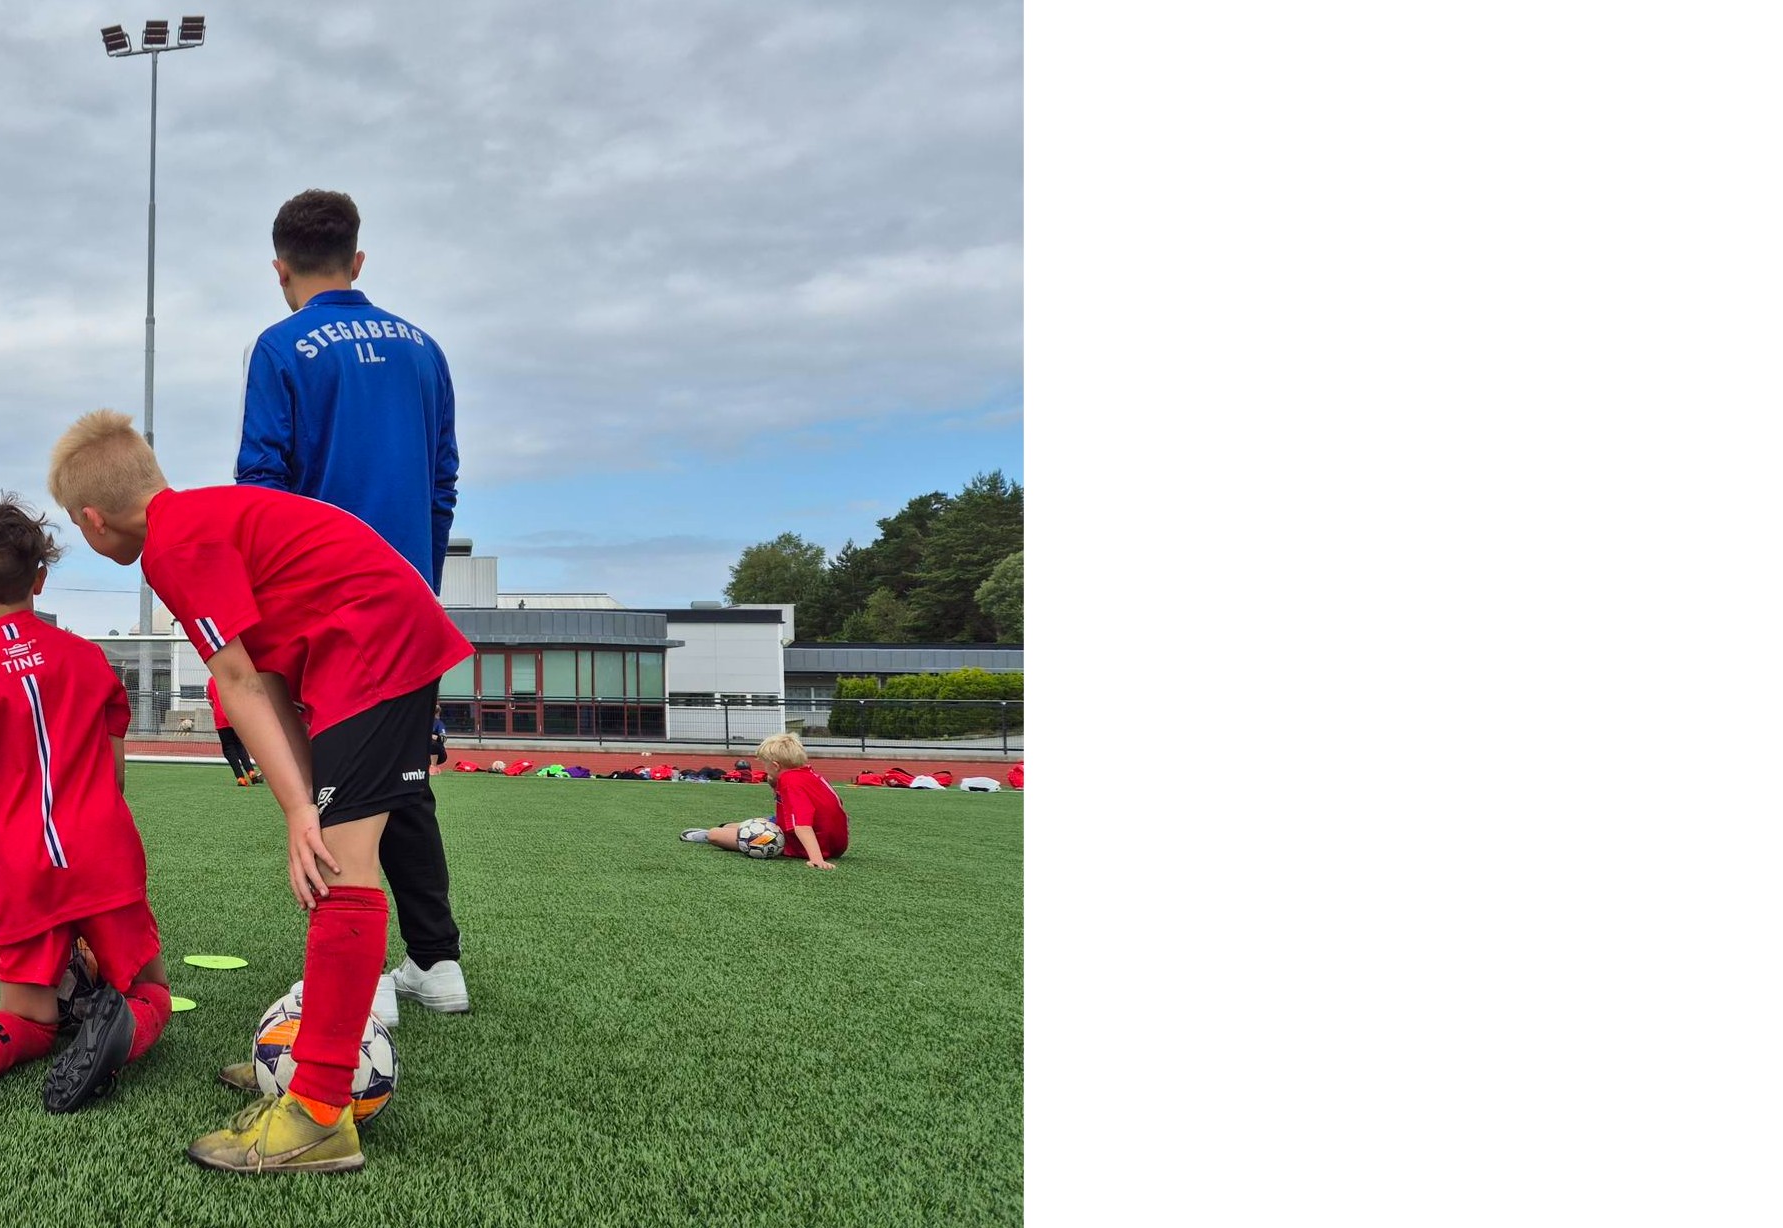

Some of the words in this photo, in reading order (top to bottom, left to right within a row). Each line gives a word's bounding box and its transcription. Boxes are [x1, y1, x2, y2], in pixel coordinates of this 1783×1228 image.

[295, 320, 425, 359] STEGABERG
[355, 342, 386, 363] I.L.
[1, 651, 45, 674] TINE
[402, 768, 426, 781] umbr
